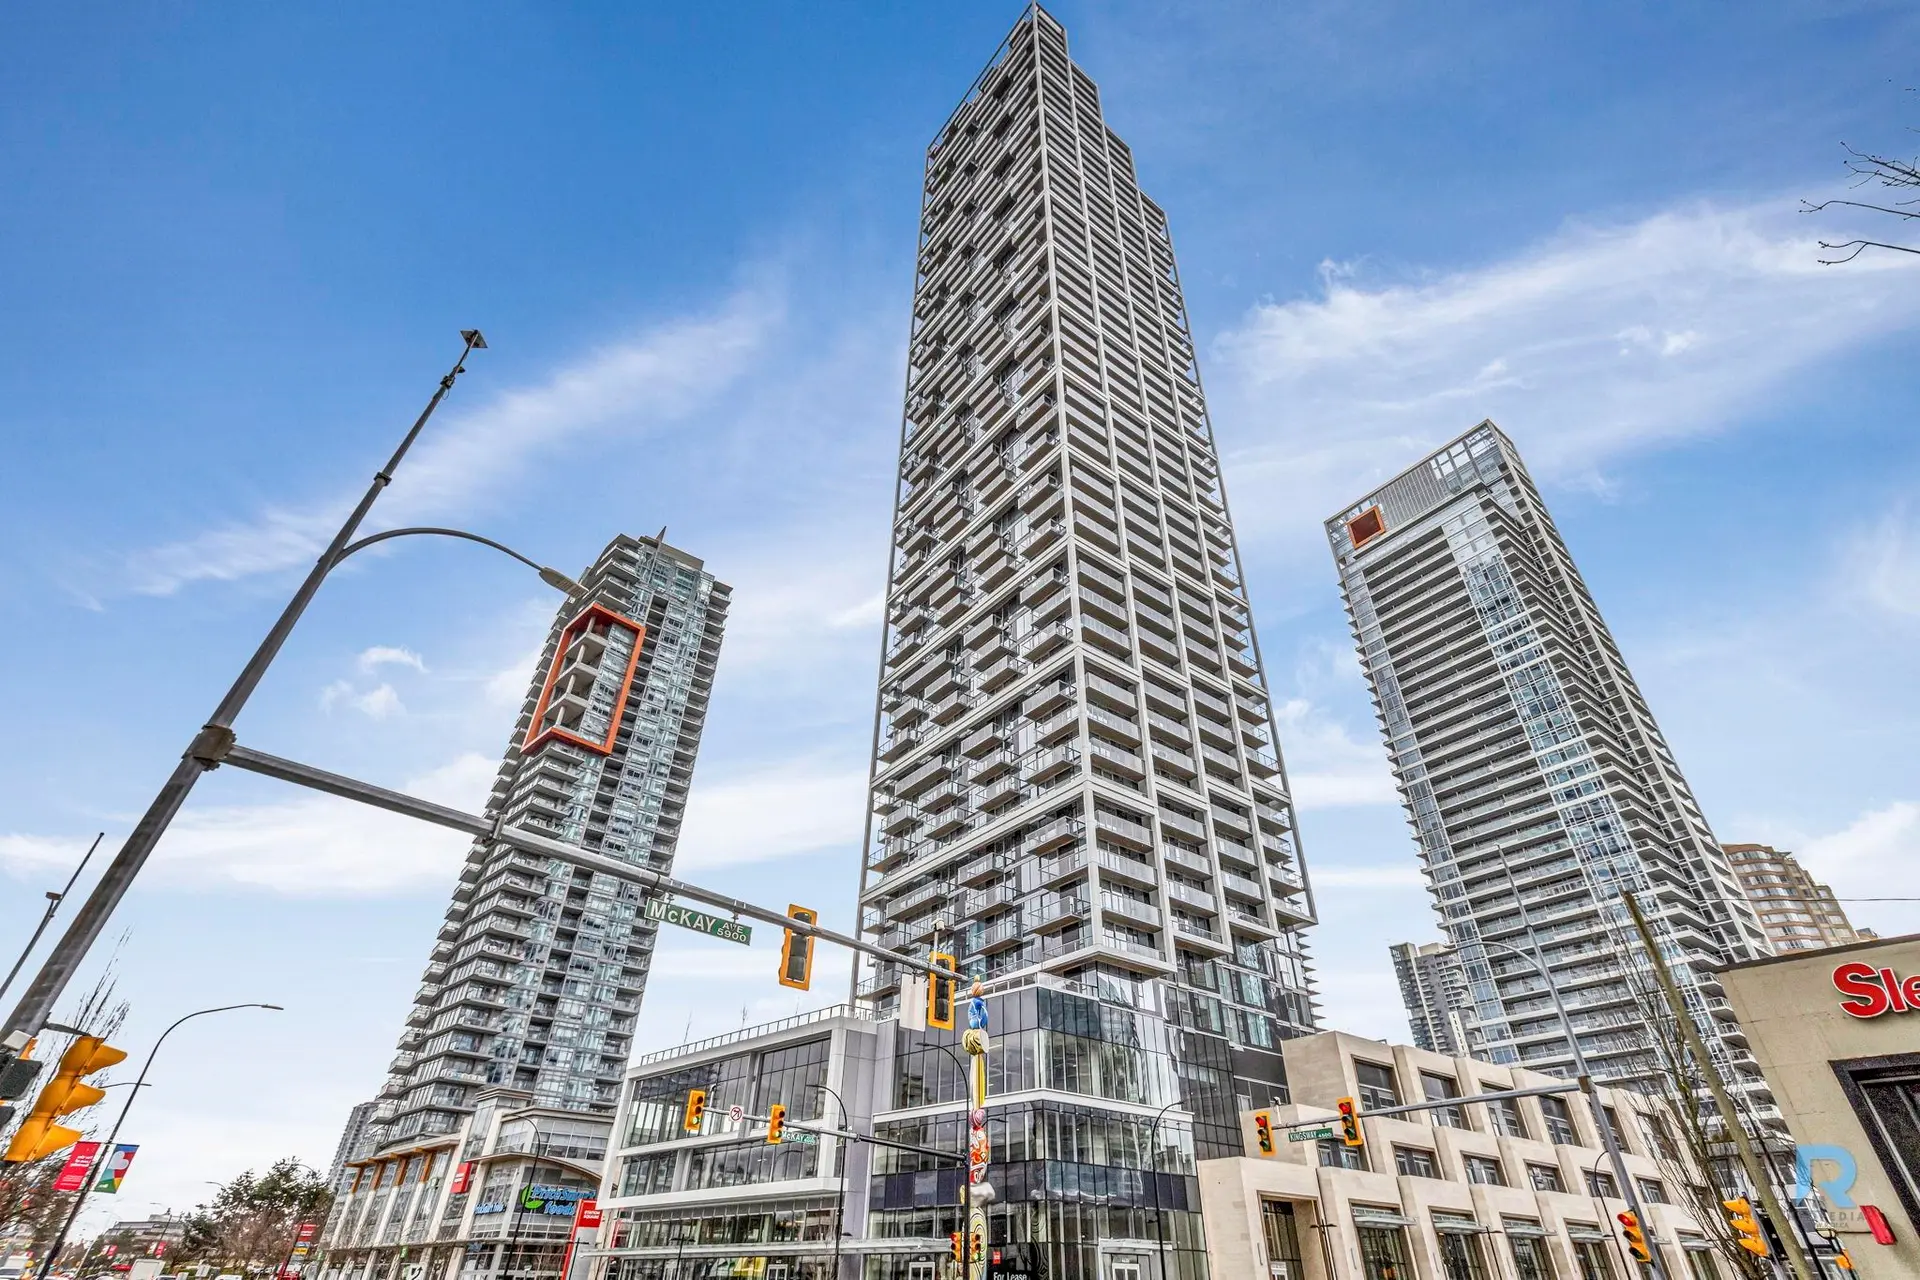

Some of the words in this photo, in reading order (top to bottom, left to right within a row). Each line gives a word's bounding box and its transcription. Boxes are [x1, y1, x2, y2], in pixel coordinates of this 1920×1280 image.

[650, 900, 717, 933] McKAY
[722, 922, 744, 934] AVE
[716, 927, 747, 942] 5900
[1832, 961, 1920, 1018] Sle
[1290, 1131, 1317, 1141] KINGSWAY
[993, 1271, 1004, 1280] For
[1006, 1271, 1028, 1280] Lease
